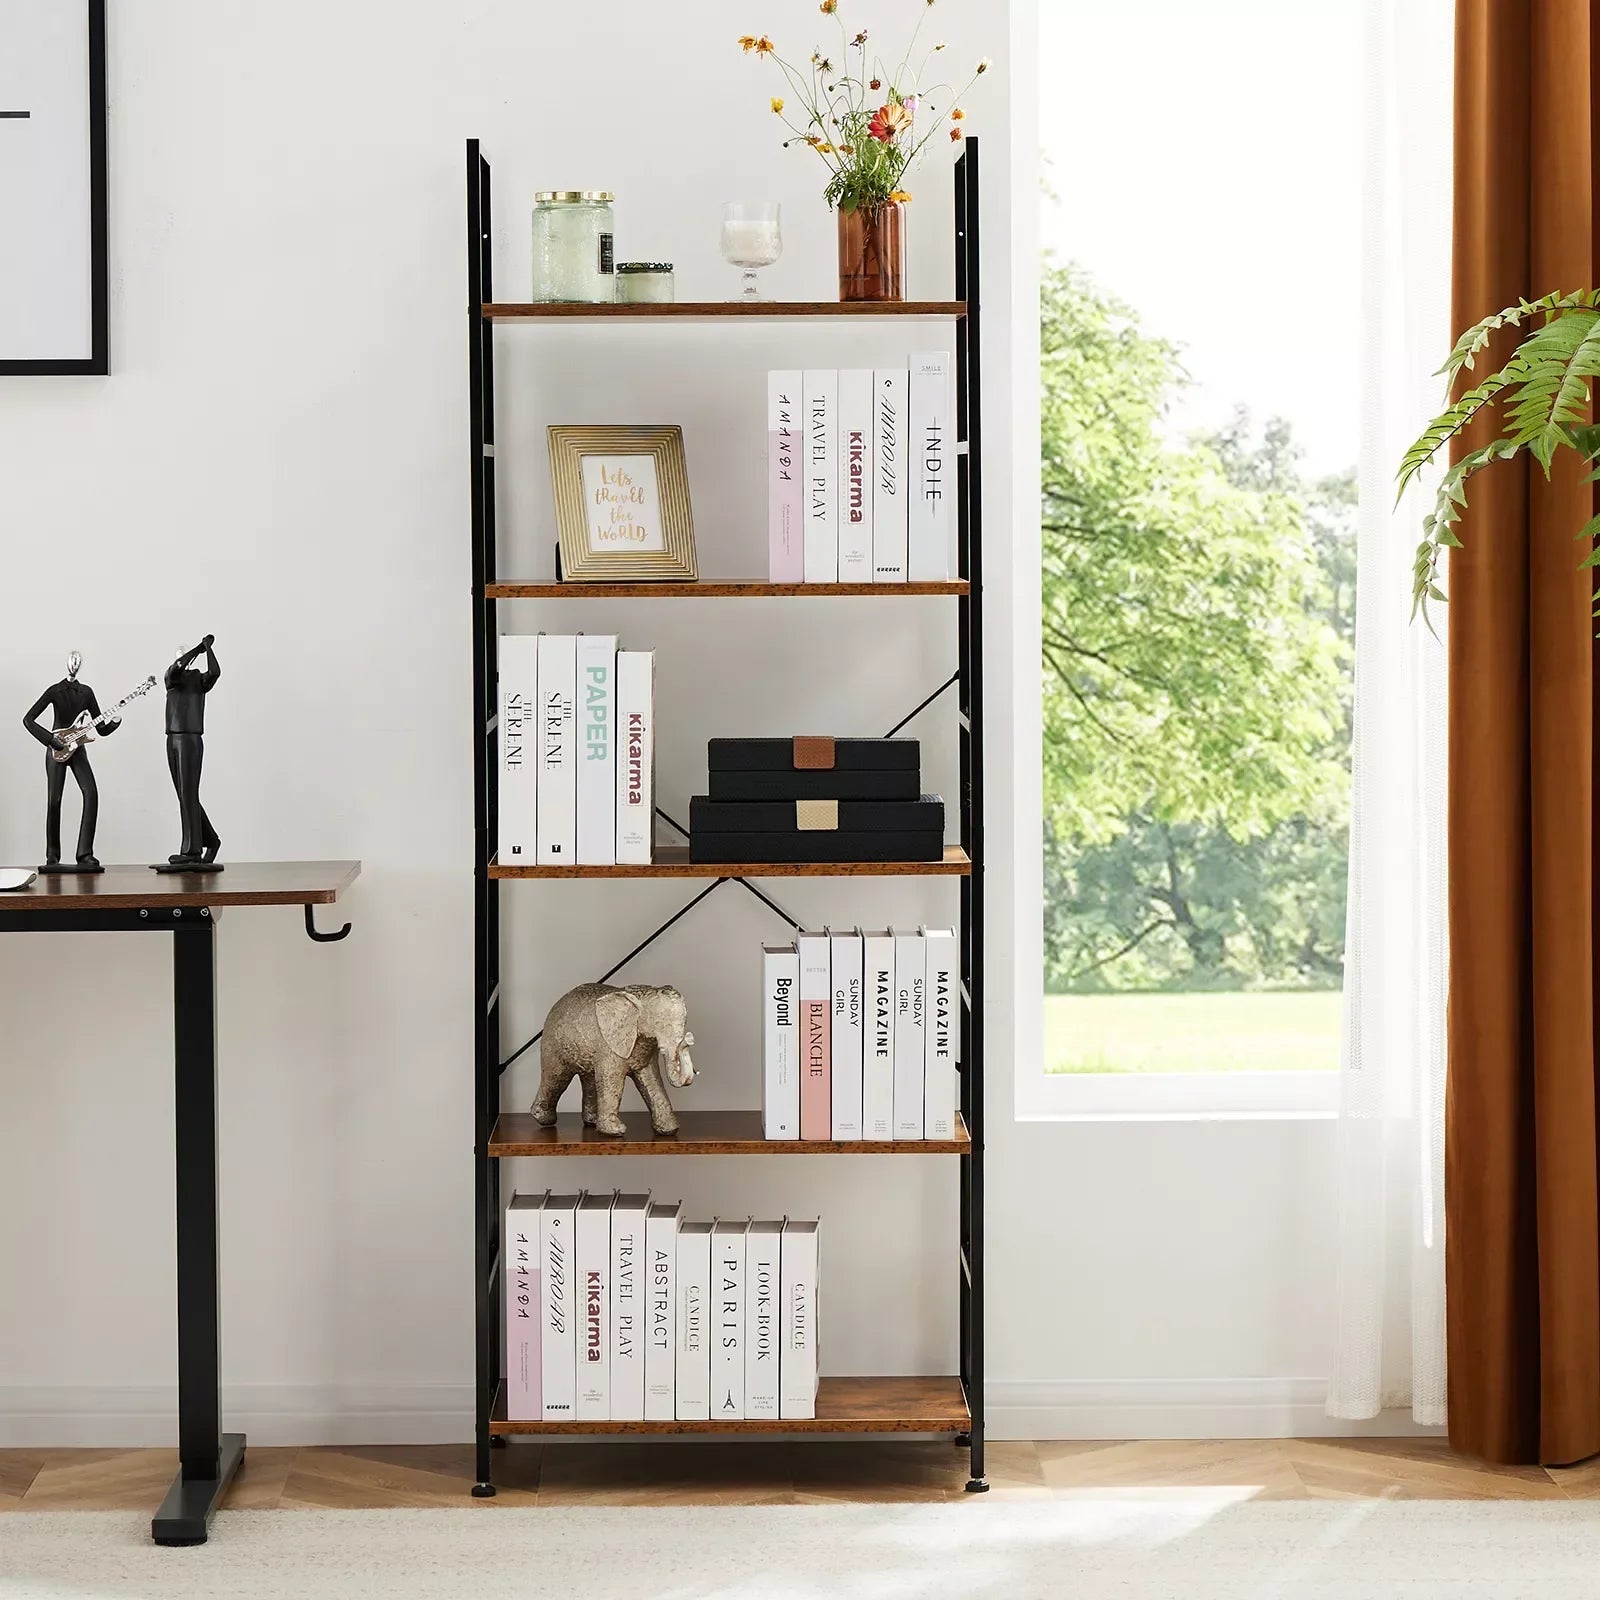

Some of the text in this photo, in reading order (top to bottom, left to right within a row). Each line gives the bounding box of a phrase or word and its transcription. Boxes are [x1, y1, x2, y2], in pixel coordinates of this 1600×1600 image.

[778, 394, 792, 481] AMANDA
[812, 395, 826, 521] TRAVEL PLAY
[926, 427, 942, 500] INDIE
[610, 506, 633, 524] the
[507, 692, 522, 772] SERENE
[523, 700, 532, 722] THE
[546, 691, 562, 770] SERENE
[563, 699, 572, 722] THE
[586, 666, 607, 761] PAPER
[773, 978, 792, 1026] Beyond
[810, 1003, 823, 1077] BLANCHE
[835, 990, 845, 1016] GIRL
[849, 978, 859, 1027] SUNDAY
[876, 970, 889, 1057] MAGAZINE
[899, 989, 908, 1015] GIRL
[913, 978, 922, 1027] SUNDAY
[936, 971, 949, 1058] MAGAZINE
[517, 1233, 530, 1319] AMANDA
[619, 1234, 633, 1359] TRAVEL PLAY
[653, 1250, 668, 1350] ABSTRACT
[723, 1260, 737, 1348] PARIS
[757, 1262, 771, 1361] LOOK-BOOK
[689, 1285, 700, 1352] CANDICE
[794, 1283, 805, 1350] CANDICE
